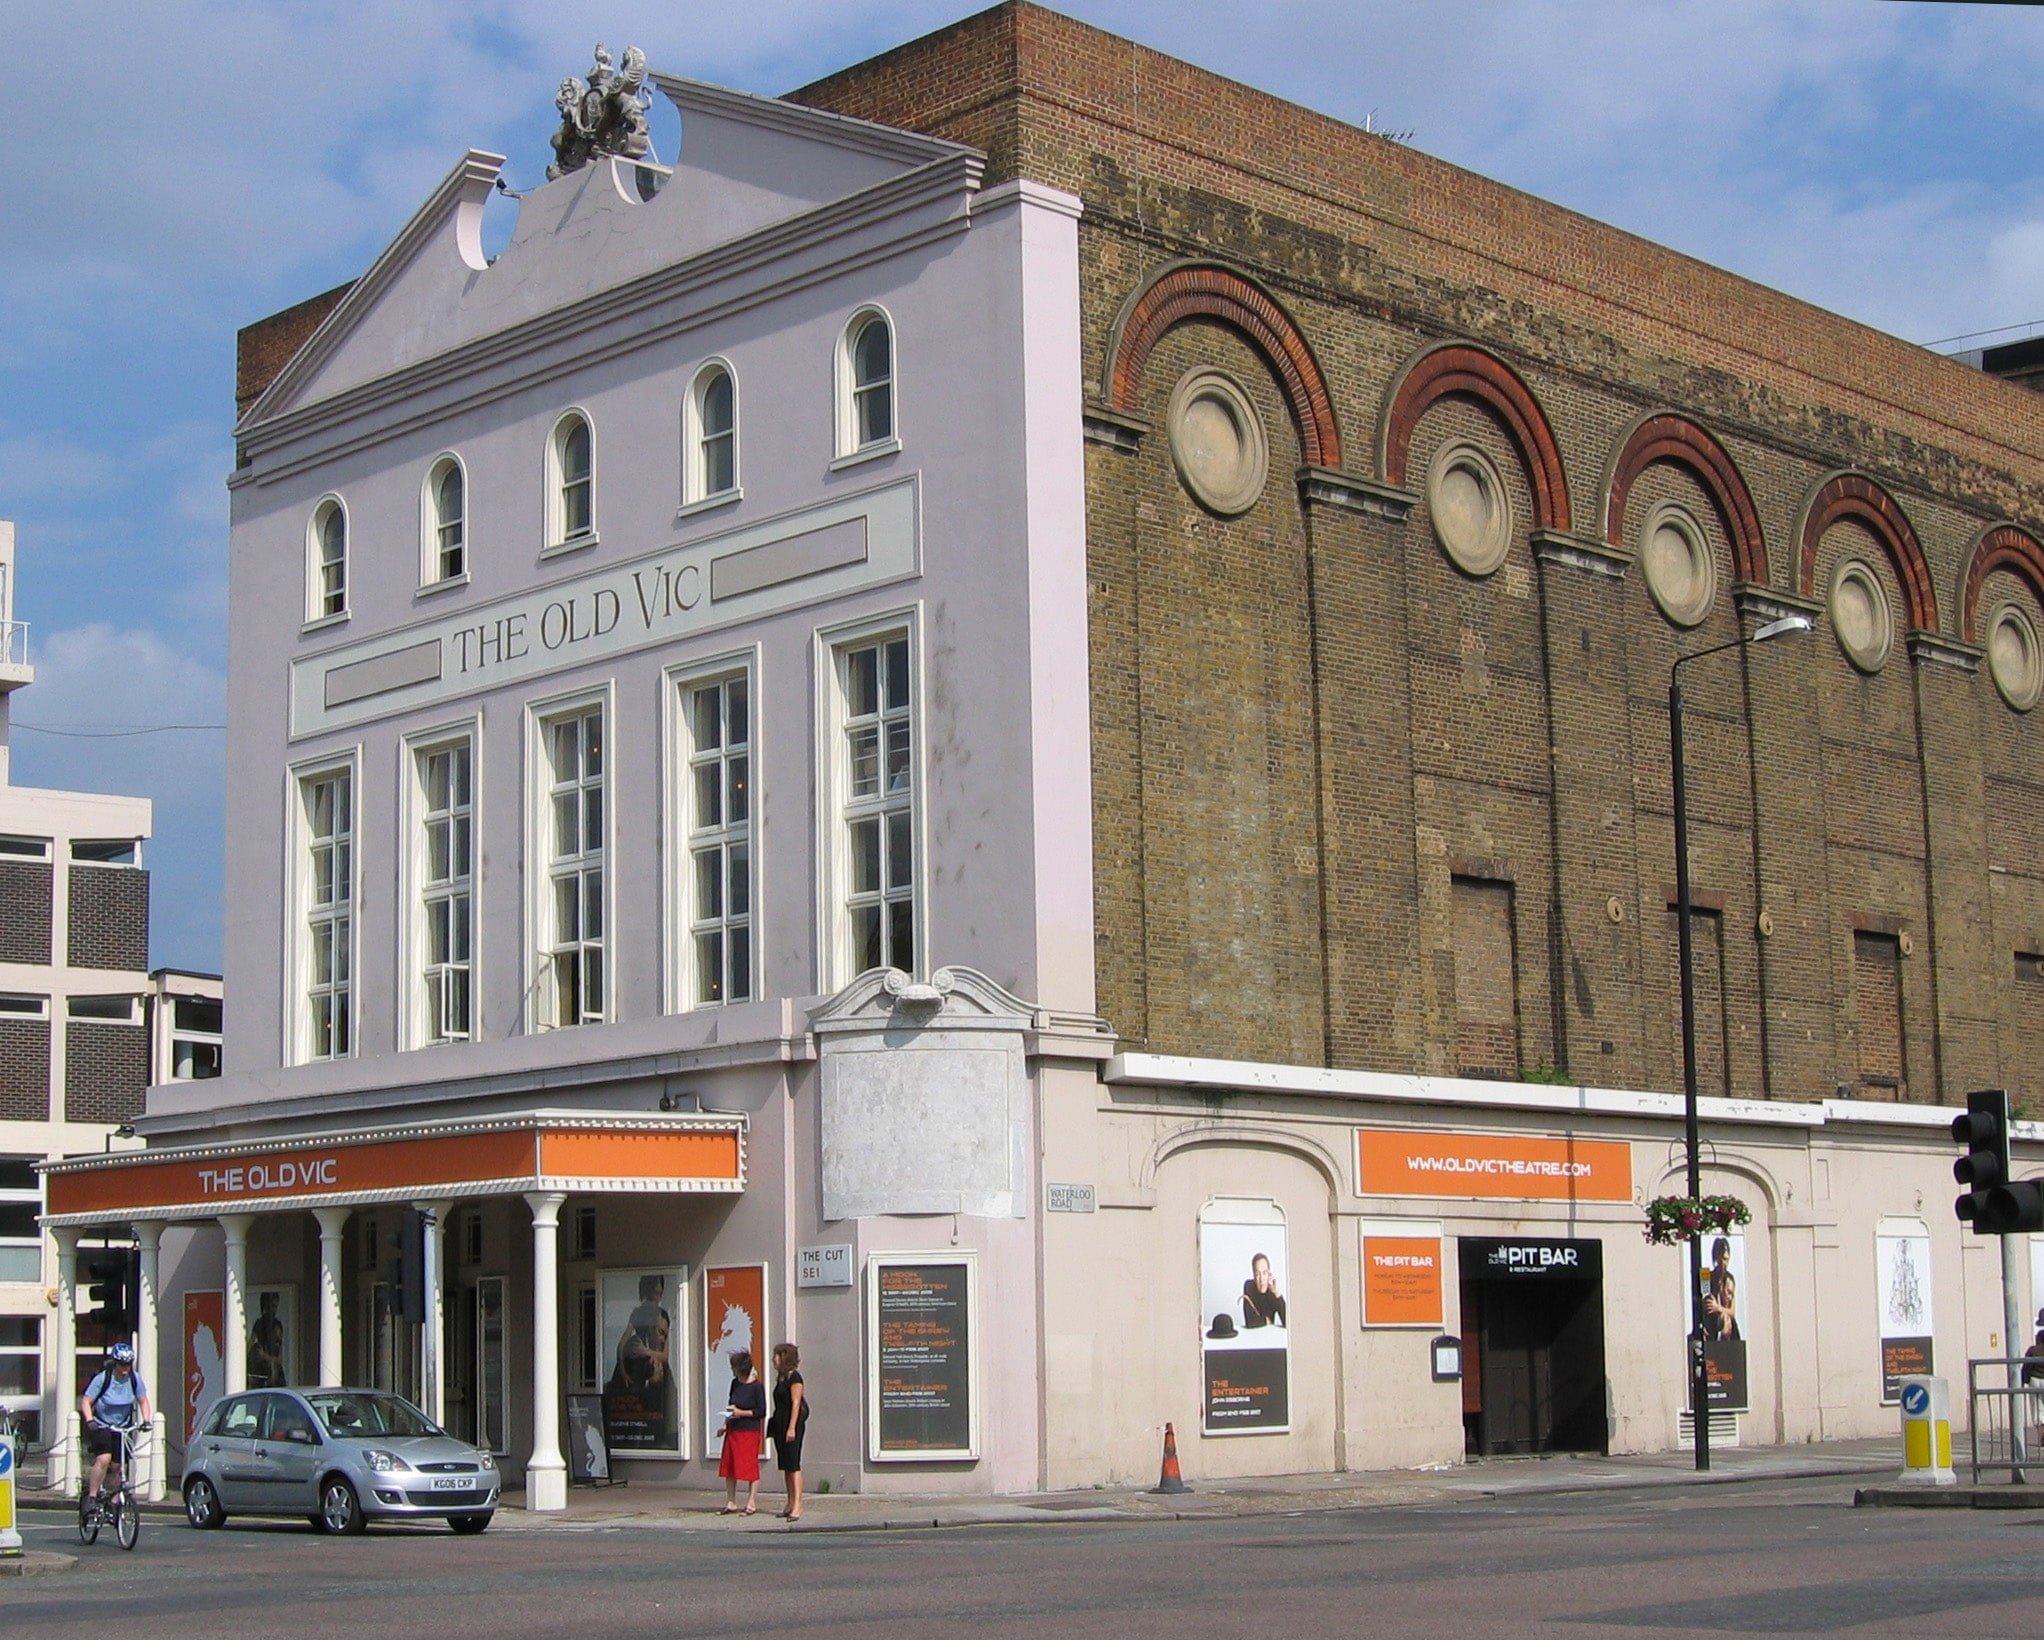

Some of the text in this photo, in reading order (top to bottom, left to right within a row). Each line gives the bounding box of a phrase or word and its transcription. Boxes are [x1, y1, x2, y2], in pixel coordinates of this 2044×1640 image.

[453, 564, 702, 673] THE OLD VIC
[1407, 1156, 1591, 1177] WWW.OLDVICTHEATRE.COM
[198, 1158, 337, 1193] THE OLD VIC
[1050, 1188, 1091, 1200] WATERLOO
[1050, 1198, 1073, 1208] ROAD
[803, 1249, 844, 1262] THE CUT
[1372, 1255, 1434, 1267] THE PIT BAR
[1508, 1247, 1578, 1266] PIT BAR
[803, 1267, 820, 1279] SE1
[1211, 1379, 1229, 1388] THE
[1211, 1386, 1269, 1397] ENTERTAINER
[434, 1478, 473, 1488] KG06 CKP
